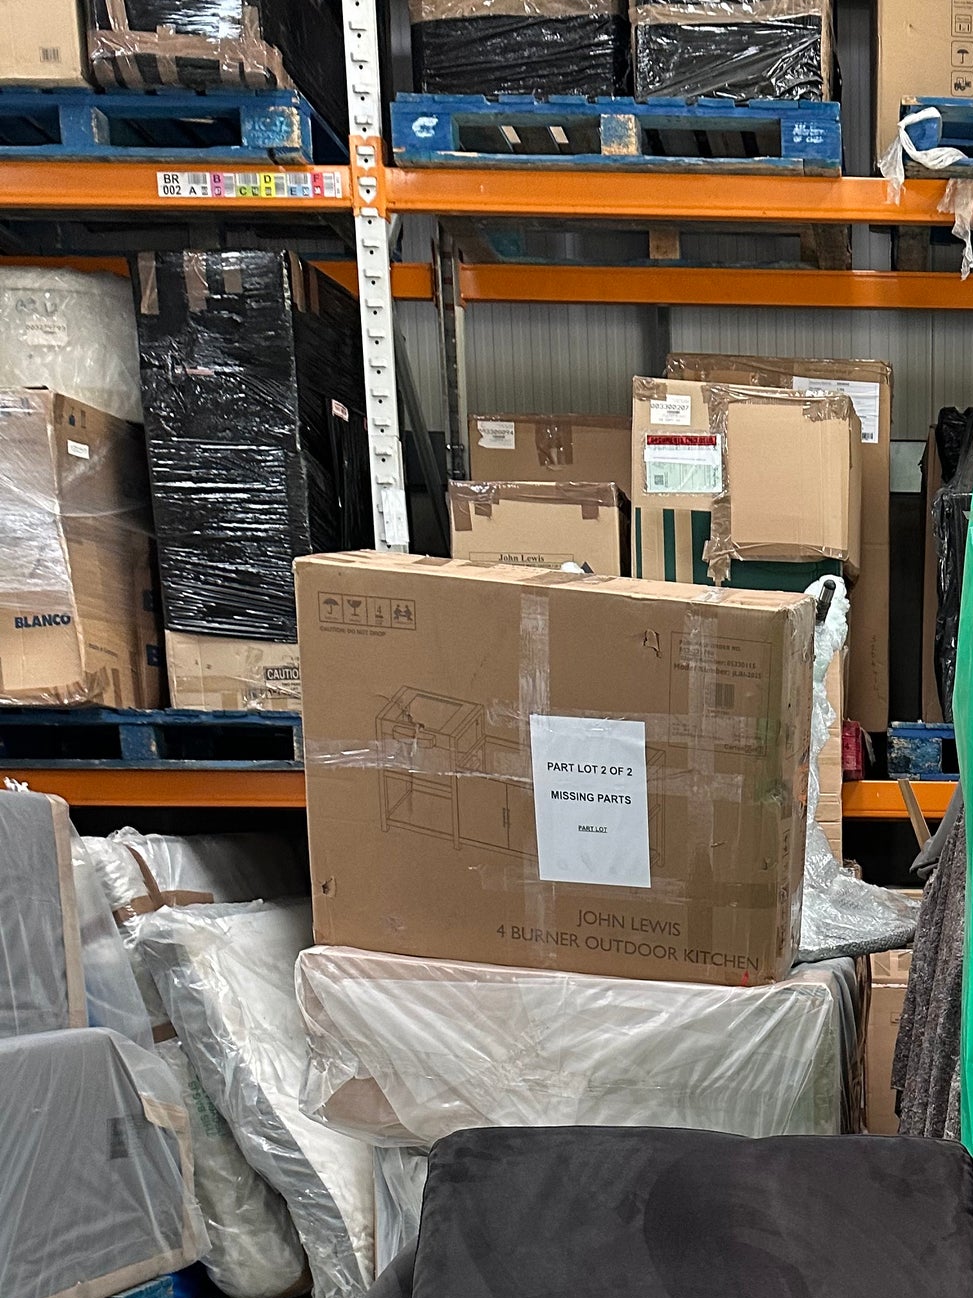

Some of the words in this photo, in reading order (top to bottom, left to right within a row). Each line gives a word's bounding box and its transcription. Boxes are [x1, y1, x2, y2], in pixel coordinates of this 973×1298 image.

[163, 173, 180, 184] BR
[213, 174, 221, 183] B
[264, 174, 272, 183] D
[162, 185, 182, 196] 002
[188, 186, 197, 195] A
[239, 186, 248, 196] C
[290, 186, 297, 195] E
[499, 554, 519, 562] John
[521, 554, 545, 563] Lewis
[15, 613, 71, 629] BLANCO
[267, 668, 299, 680] CAUTIO
[547, 762, 574, 772] PART
[577, 764, 598, 774] LOT
[601, 766, 607, 774] 2
[609, 766, 624, 775] OF
[627, 767, 633, 776] 2
[551, 790, 594, 802] MISSING
[597, 793, 632, 805] PARTS
[576, 909, 625, 929] JOHN
[631, 916, 681, 937] LEWIS
[496, 925, 506, 938] 4
[511, 925, 581, 948] BURNER
[585, 935, 679, 961] OUTDOOR
[684, 948, 760, 971] KITCHEN
